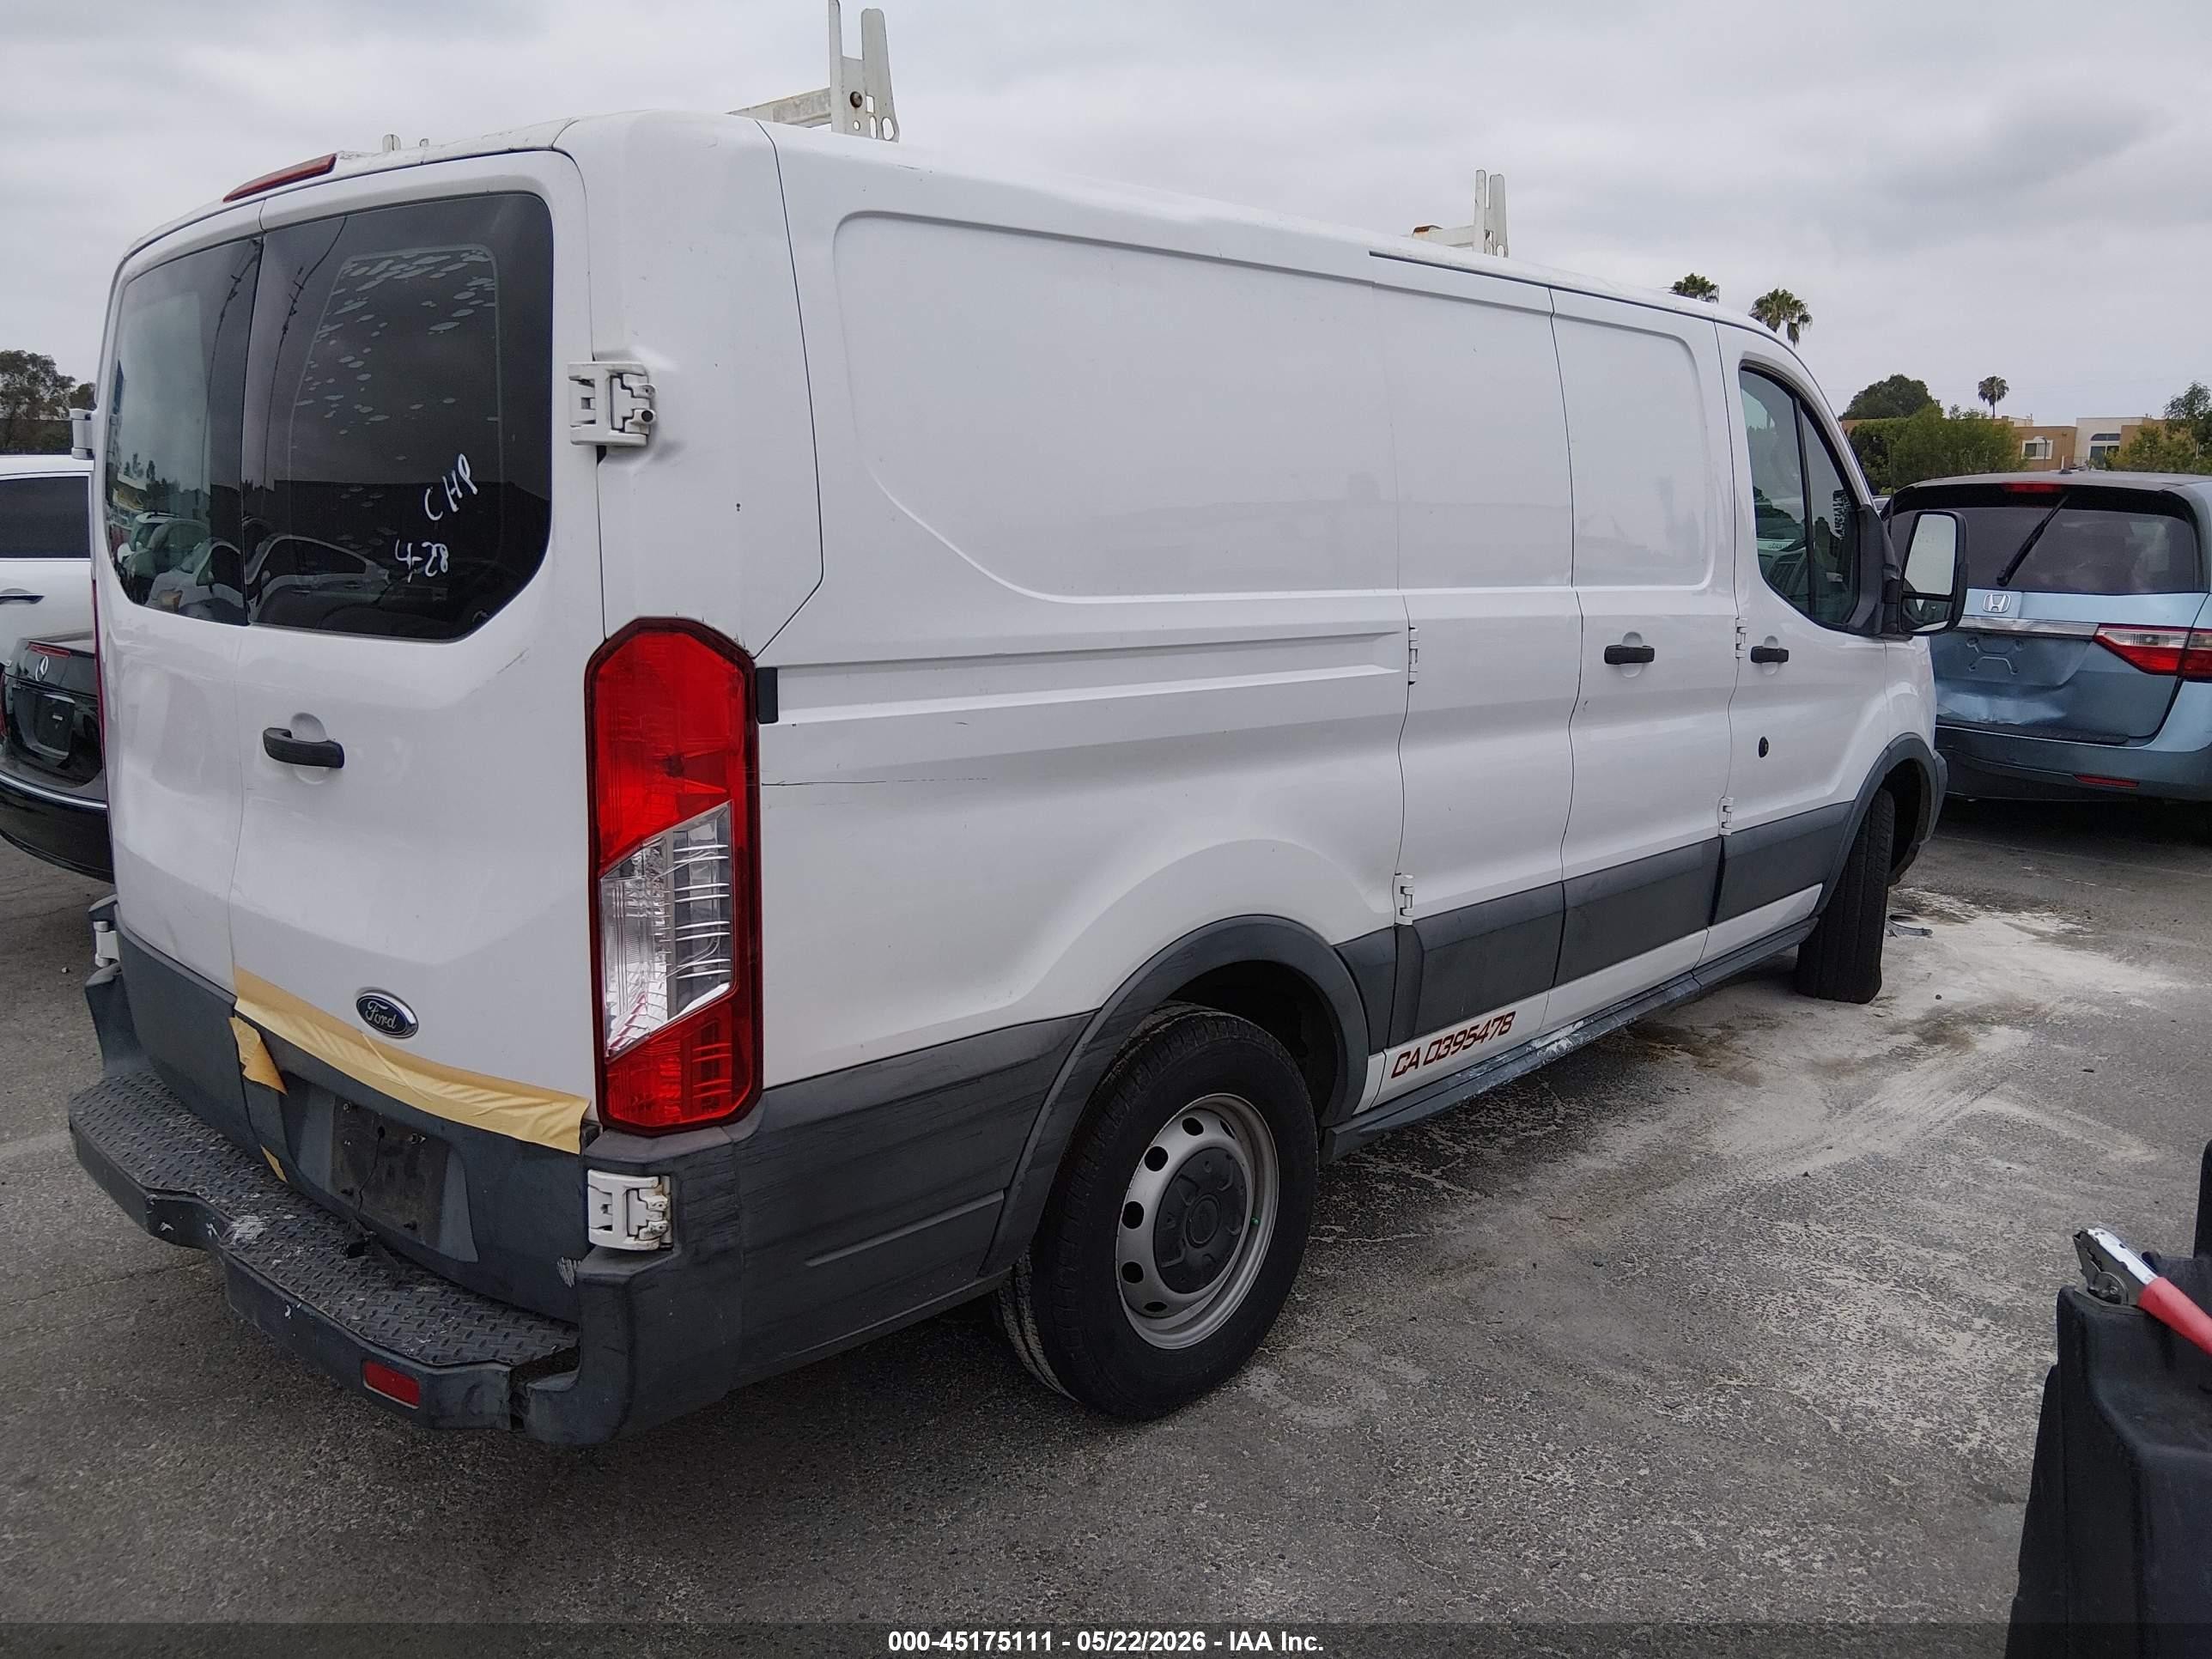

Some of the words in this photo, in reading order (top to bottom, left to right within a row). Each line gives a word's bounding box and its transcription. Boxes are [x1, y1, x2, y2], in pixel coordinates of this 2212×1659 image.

[424, 453, 478, 521] CHP
[365, 1000, 398, 1030] Ford
[1391, 1047, 1421, 1079] CA
[1423, 1011, 1516, 1066] 0395478
